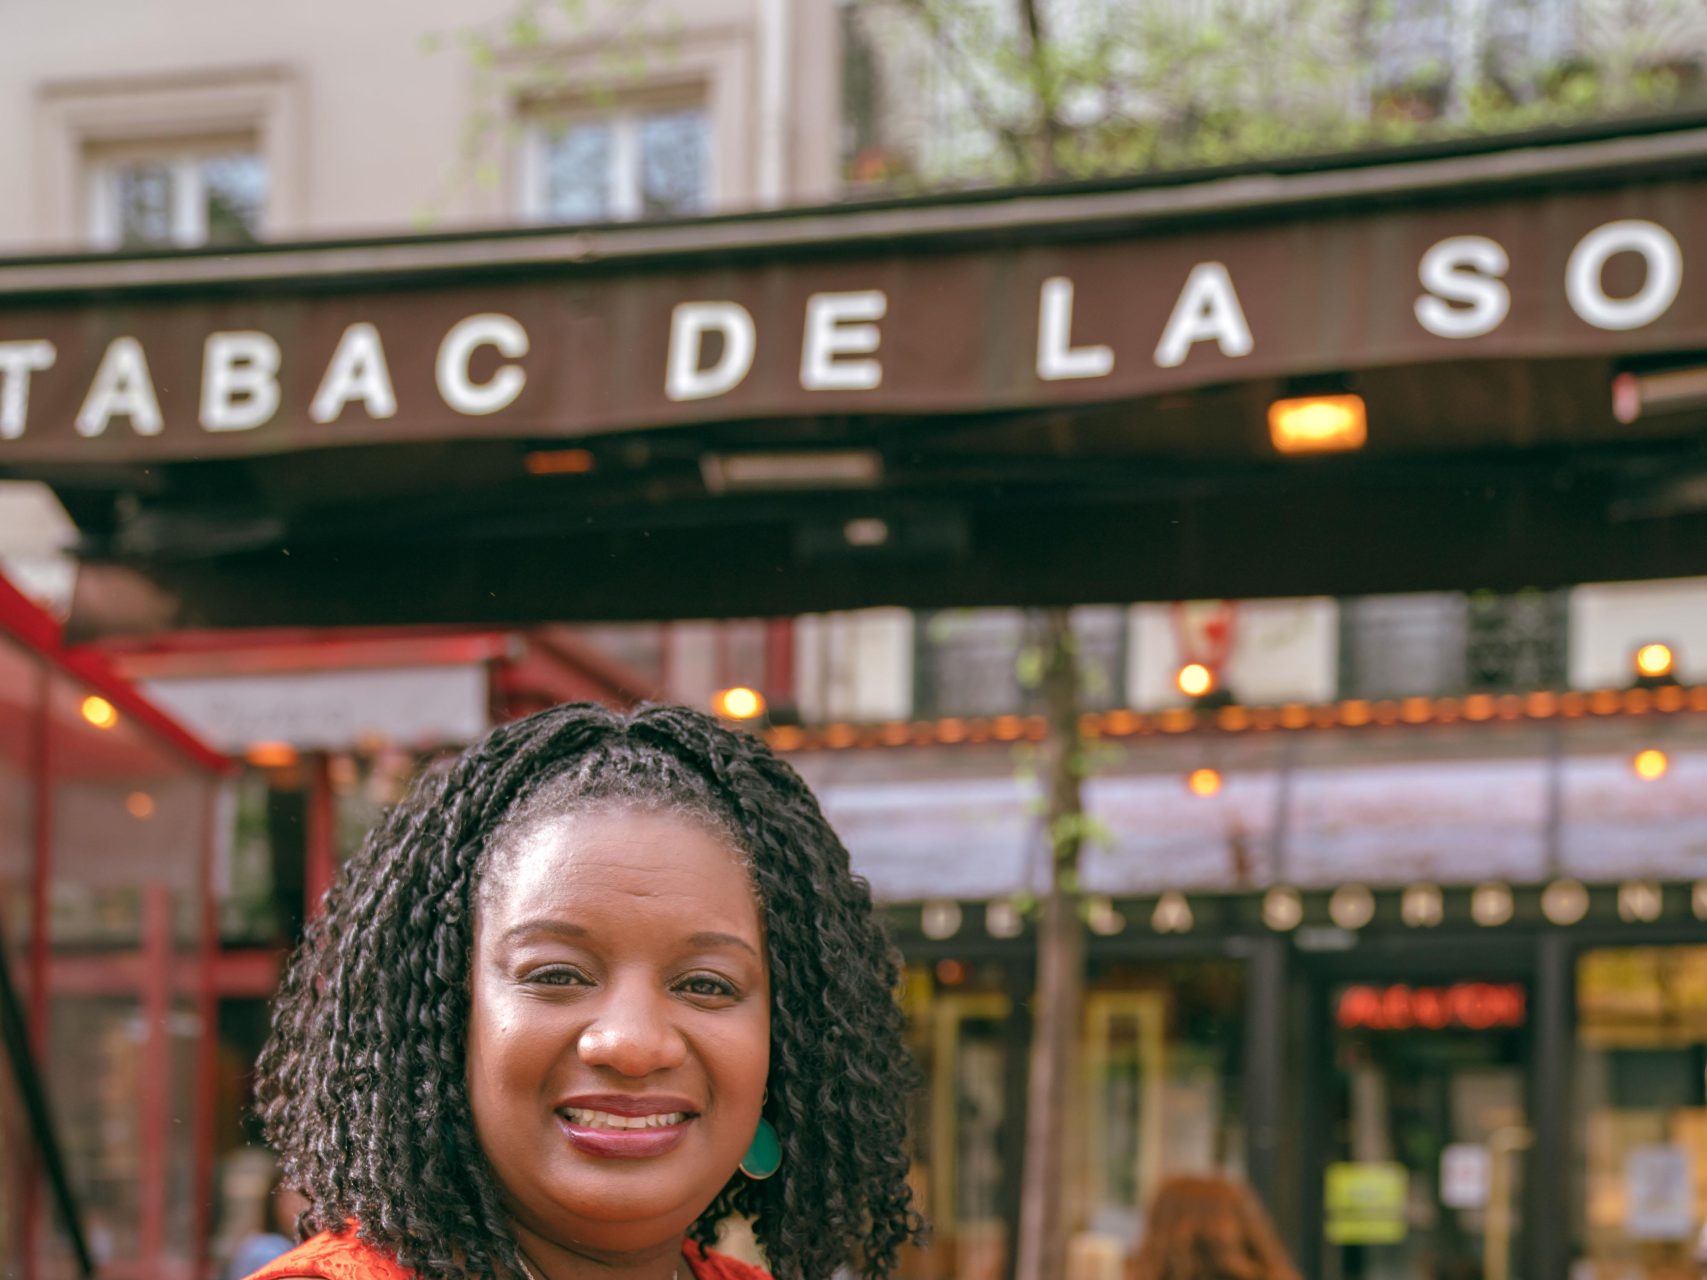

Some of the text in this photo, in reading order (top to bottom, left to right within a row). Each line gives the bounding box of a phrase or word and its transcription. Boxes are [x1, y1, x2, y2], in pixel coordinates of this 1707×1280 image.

[0, 219, 1683, 439] TABAC DE LA SO
